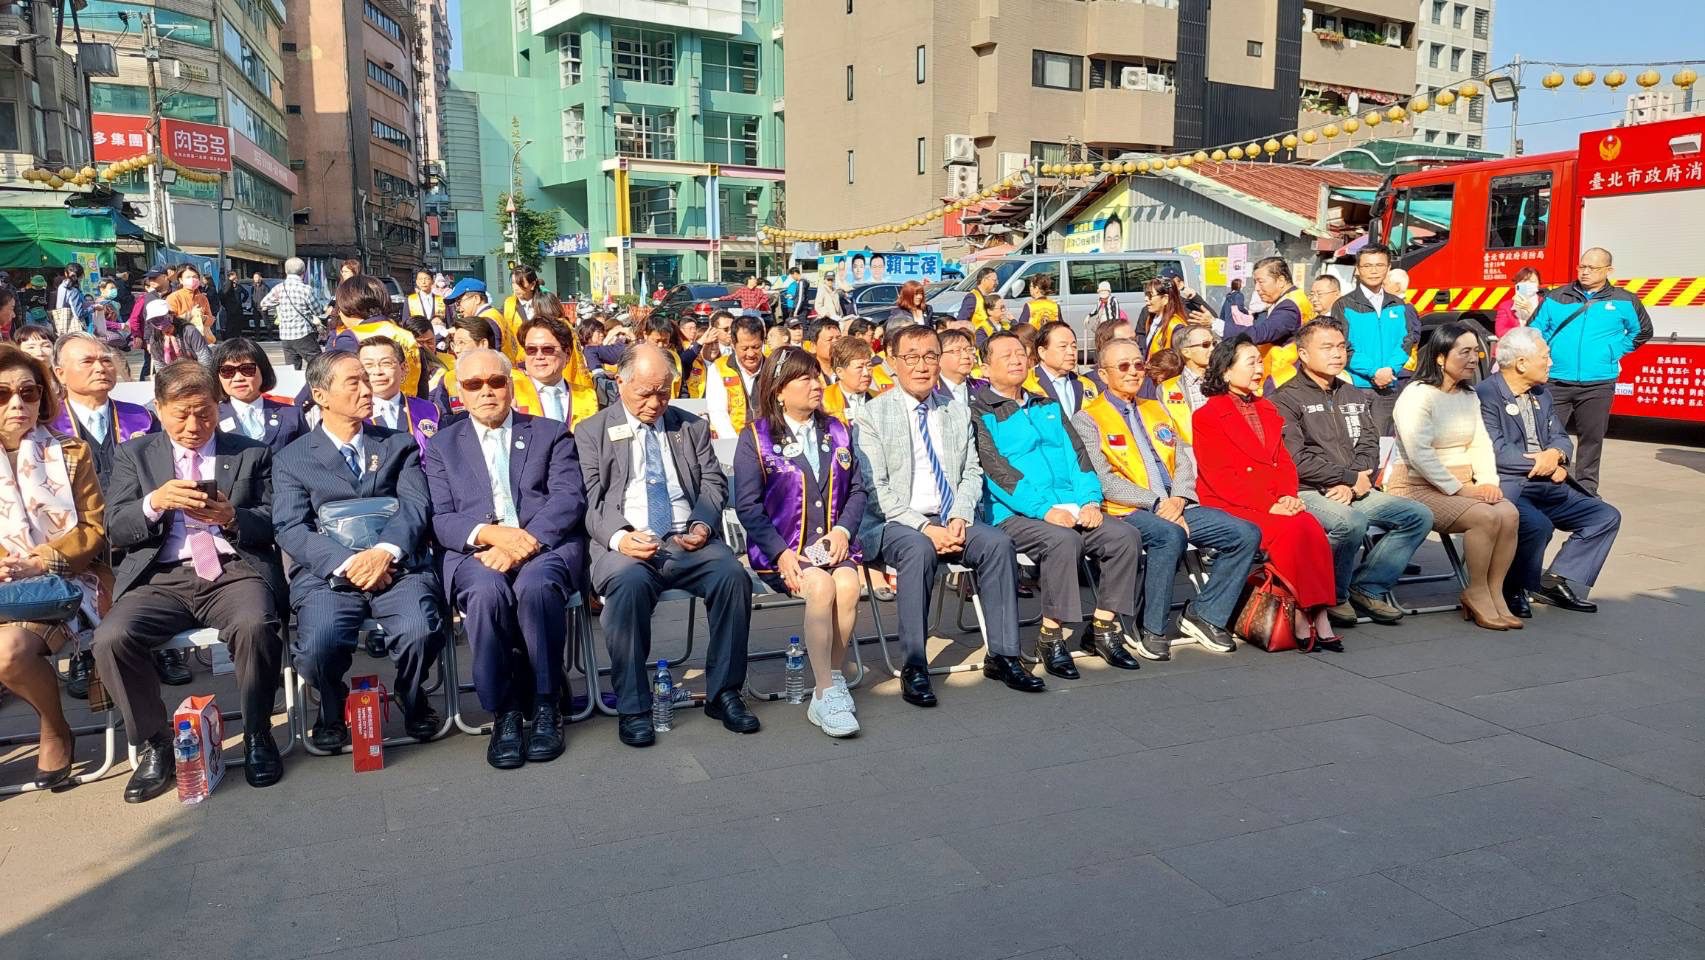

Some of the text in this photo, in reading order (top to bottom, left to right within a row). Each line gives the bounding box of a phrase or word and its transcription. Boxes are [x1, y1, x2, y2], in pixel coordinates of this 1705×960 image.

[94, 131, 143, 148] 多集團
[174, 129, 226, 156] 肉多多
[1589, 161, 1703, 191] 臺北市政府消
[886, 255, 937, 275] 賴士葆
